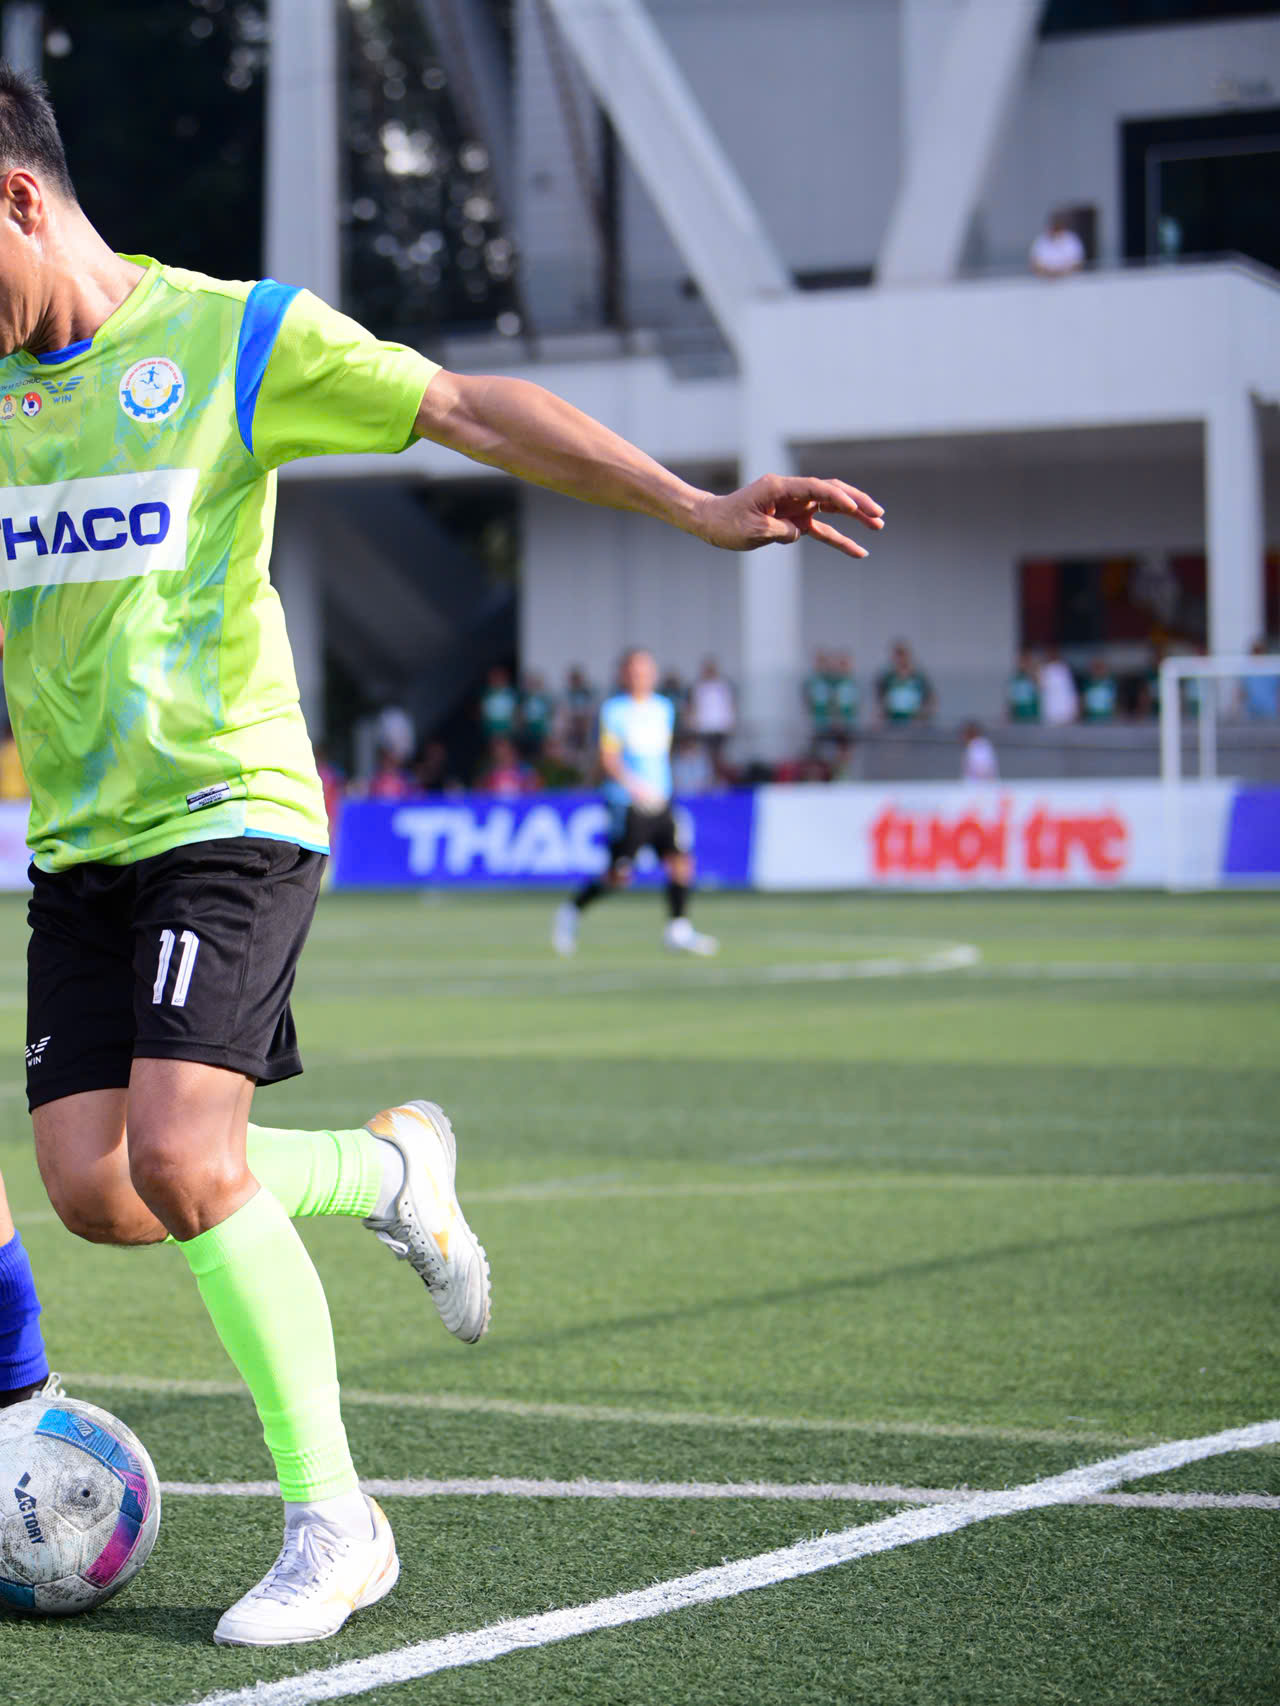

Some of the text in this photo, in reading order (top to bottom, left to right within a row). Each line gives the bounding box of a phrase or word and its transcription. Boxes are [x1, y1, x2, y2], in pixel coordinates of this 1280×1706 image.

[53, 394, 72, 404] WIN
[393, 803, 618, 877] THAC
[152, 929, 200, 1007] 11
